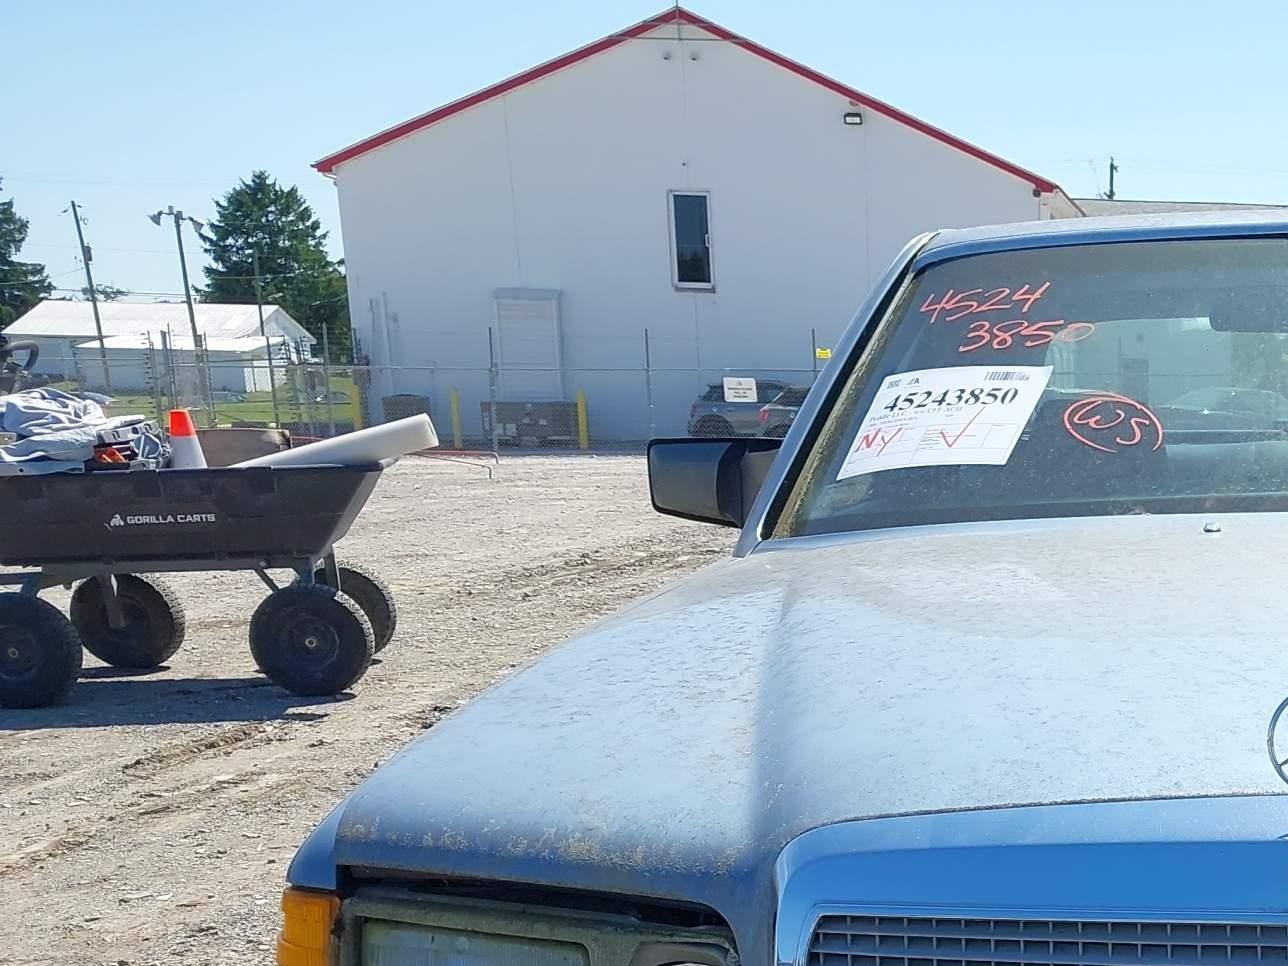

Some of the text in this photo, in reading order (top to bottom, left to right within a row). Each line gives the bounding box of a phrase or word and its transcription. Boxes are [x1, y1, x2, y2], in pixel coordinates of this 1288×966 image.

[920, 281, 1051, 323] 4524
[958, 320, 1095, 352] 3850
[884, 387, 1018, 412] 45243850
[854, 425, 903, 457] NY
[127, 513, 216, 525] GORILLA CARTS
